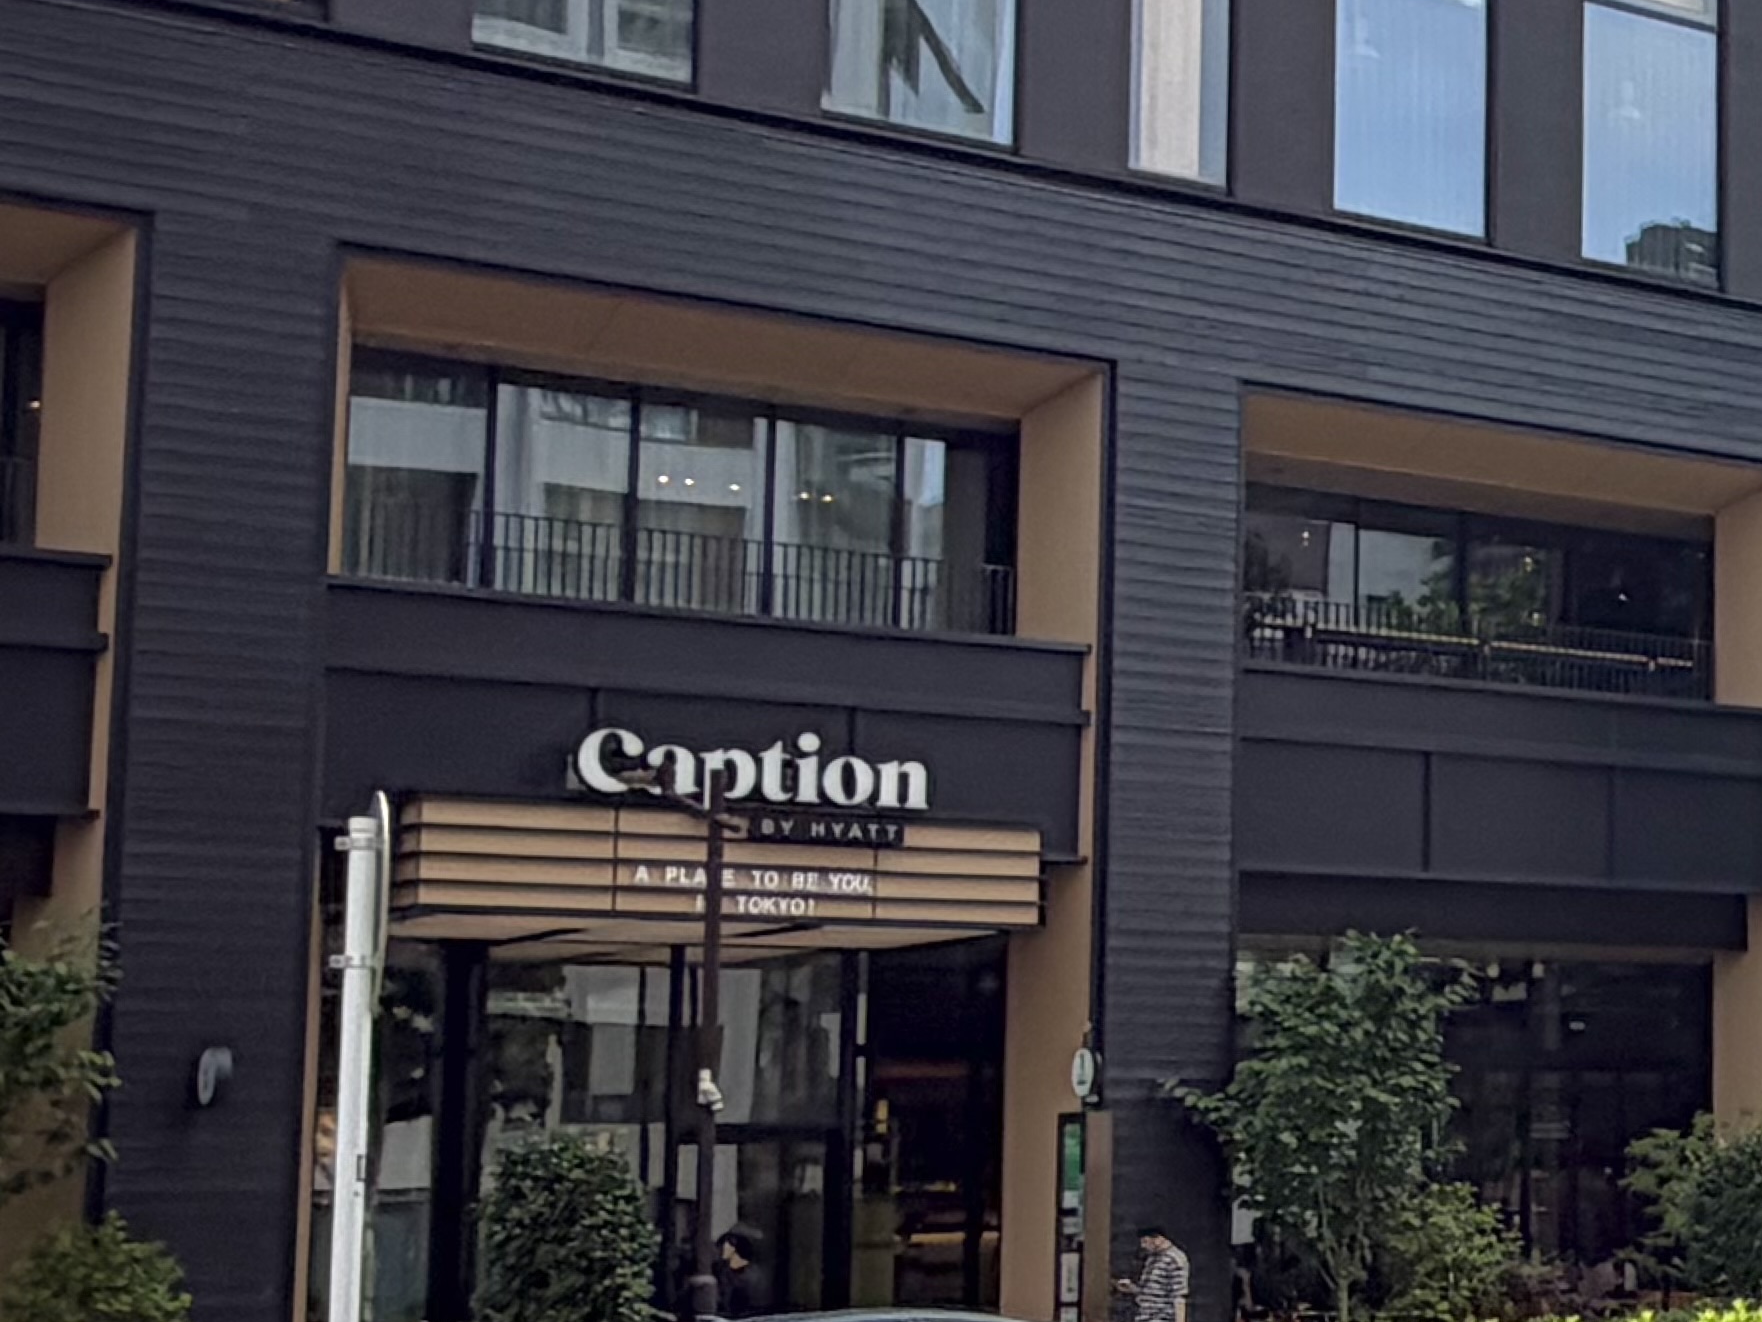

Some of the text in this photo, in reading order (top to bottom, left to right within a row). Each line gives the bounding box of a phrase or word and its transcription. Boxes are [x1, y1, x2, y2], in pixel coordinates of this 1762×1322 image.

[577, 727, 929, 810] Caption
[760, 818, 900, 841] BY HYATT
[633, 865, 649, 883] A
[664, 866, 736, 888] PLAE
[751, 869, 780, 889] TO
[791, 871, 820, 891] BE
